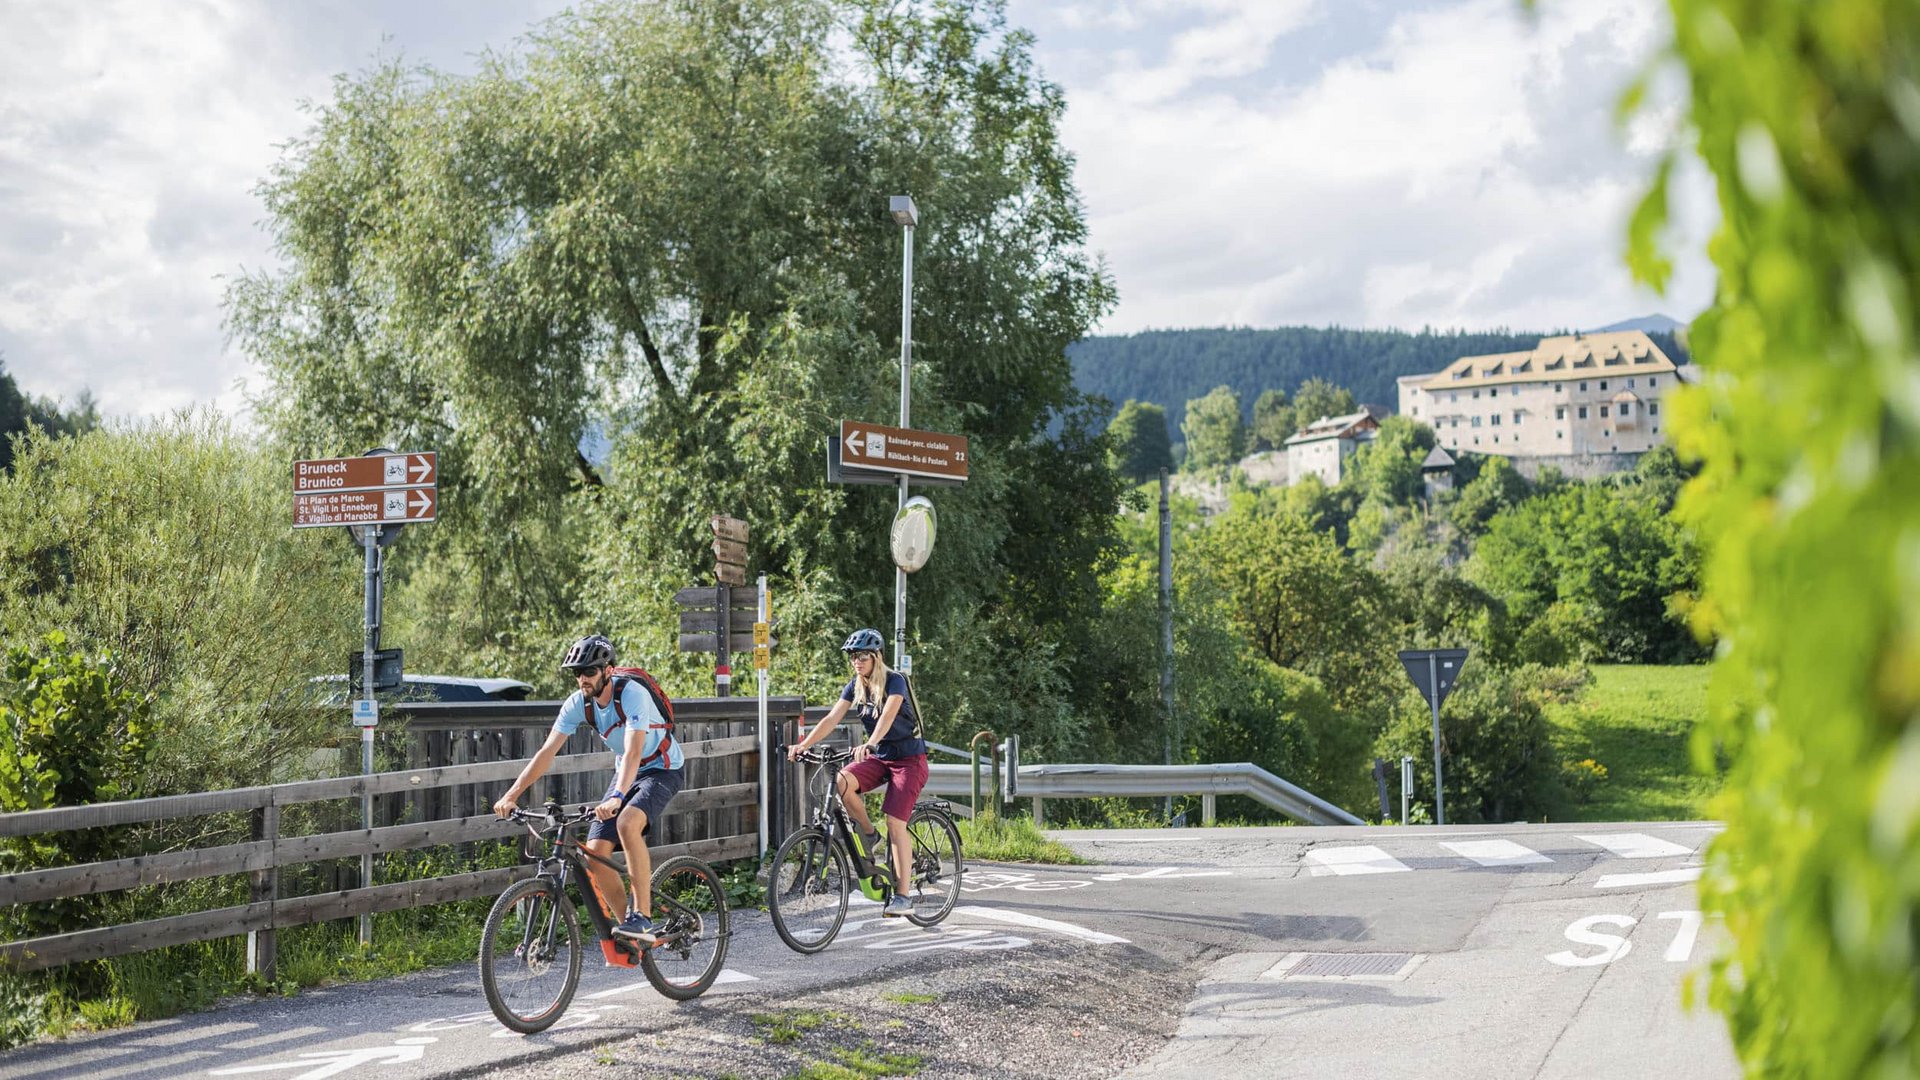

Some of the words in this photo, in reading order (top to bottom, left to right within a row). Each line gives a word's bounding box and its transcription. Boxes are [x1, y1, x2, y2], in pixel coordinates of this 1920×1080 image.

[926, 441, 949, 451] ciclabile
[955, 451, 965, 461] 22
[300, 461, 347, 475] Bruneck
[299, 476, 344, 489] Brunico
[299, 497, 308, 505] Al
[309, 496, 327, 505] Plan
[329, 495, 339, 503] de
[340, 494, 365, 502] Mareo
[299, 506, 310, 514] St.
[312, 505, 330, 514] Vigil
[331, 504, 339, 512] in
[341, 503, 378, 512] Enneberg
[298, 515, 307, 523] S.
[309, 514, 333, 523] Vigilio
[334, 513, 341, 521] di
[344, 512, 378, 521] Marebbe
[1544, 910, 1725, 967] ST
